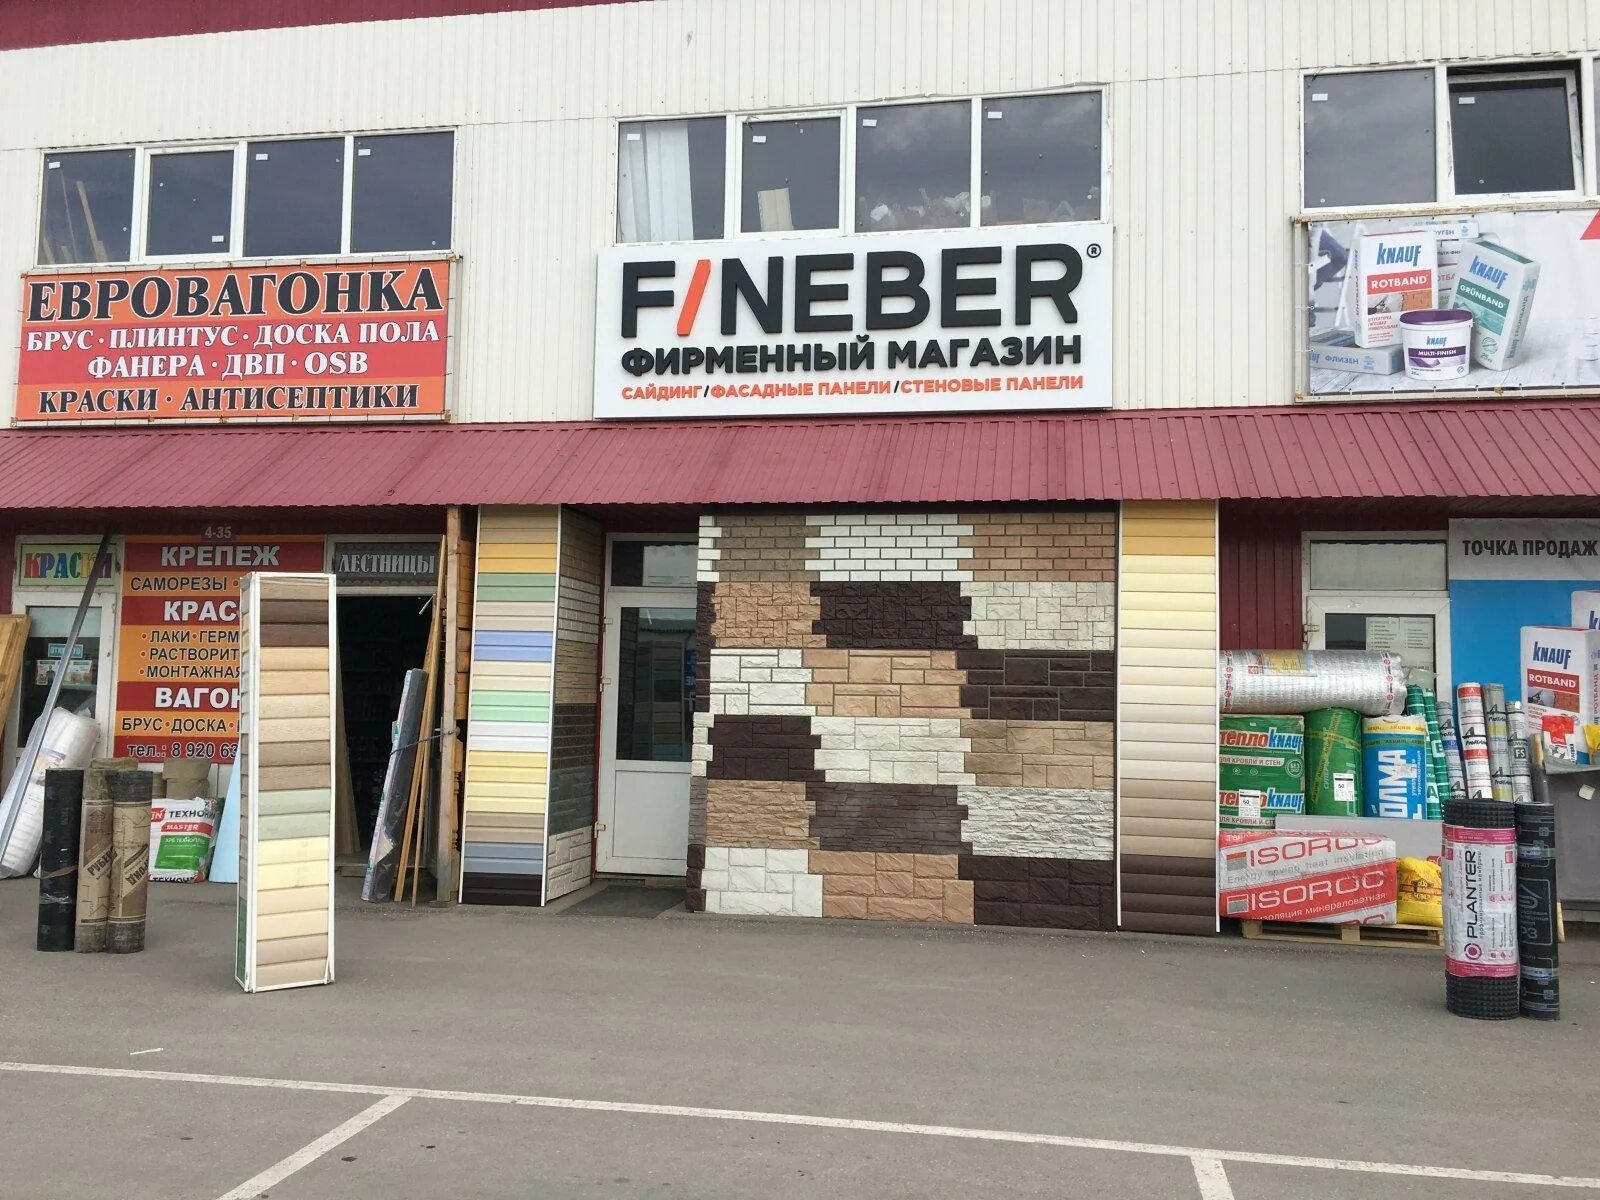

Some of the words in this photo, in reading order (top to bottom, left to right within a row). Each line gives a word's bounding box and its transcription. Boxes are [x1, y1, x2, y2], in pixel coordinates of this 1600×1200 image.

[1371, 275, 1428, 289] ROTBAND
[27, 267, 443, 322] ЕВРОВАГОНКА
[1460, 284, 1505, 309] GRÜNBAND
[26, 329, 94, 351] БРУС
[108, 324, 239, 349] ПЛИНТУС
[253, 324, 350, 350] ДОСКА
[359, 320, 440, 344] ПОЛА
[621, 334, 875, 376] ФИРМЕННЫЙ
[888, 335, 1082, 369] МАГАЗИН
[1324, 355, 1359, 364] ФЛИЗЕН
[87, 353, 206, 379] ФАНЕРА
[221, 353, 285, 380] ДВП
[304, 351, 369, 376] OSB
[1006, 375, 1084, 391] ПАНЕЛИ
[39, 388, 158, 413] КРАСКИ
[181, 384, 420, 411] АНТИСЕПТИКИ
[204, 526, 232, 539] 4-35
[161, 545, 281, 567] КРЕПЕЖ
[1462, 539, 1519, 556] ТОЧКА
[1522, 539, 1599, 558] ПРОДАЖ
[338, 553, 436, 576] ЛЕСТНИЦЫ
[130, 576, 228, 591] САМОРЕЗЫ
[164, 600, 240, 622] КРАС
[150, 631, 190, 643] ЛАКИ
[1528, 673, 1576, 689] ROTBAND
[122, 717, 162, 731] БРУС
[171, 719, 227, 733] ДОСКА
[171, 743, 181, 757] 8
[186, 743, 215, 758] 920
[1515, 748, 1526, 758] FS
[1232, 757, 1257, 765] КРОВЛИ
[166, 823, 200, 832] MASTER
[1305, 858, 1329, 870] heat
[1251, 870, 1385, 911] ISOROC
[1465, 850, 1477, 939] PLANTER
[1305, 892, 1386, 916] минераловатная
